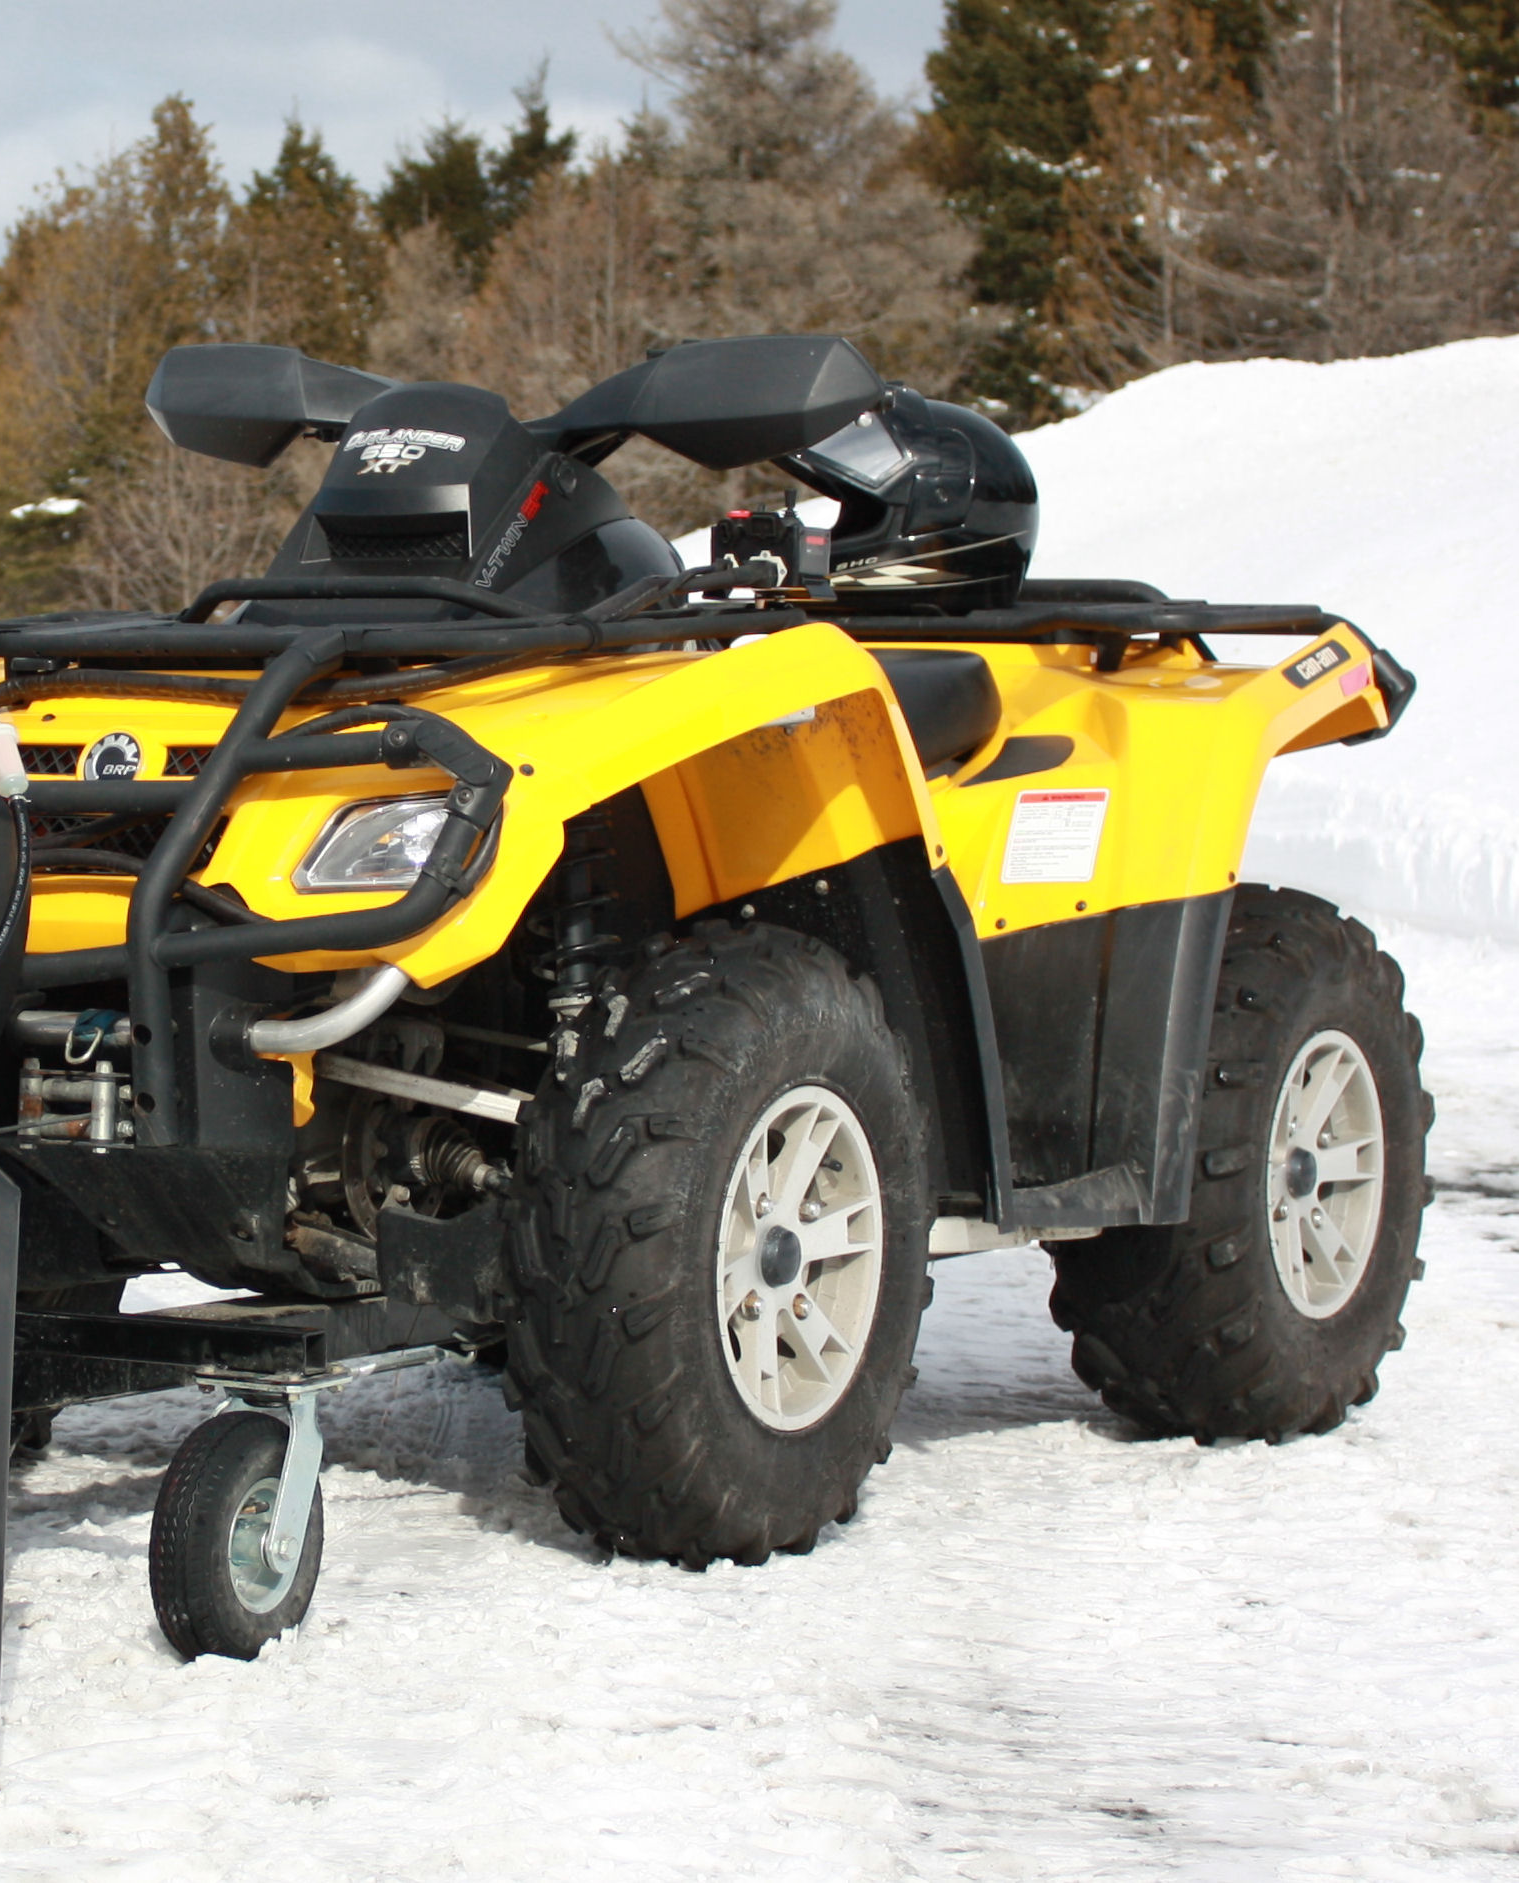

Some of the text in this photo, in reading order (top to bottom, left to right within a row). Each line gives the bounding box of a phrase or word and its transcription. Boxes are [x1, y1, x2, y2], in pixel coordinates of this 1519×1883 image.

[343, 428, 466, 452] OUTLANDER
[359, 443, 426, 460] 650
[357, 460, 412, 475] XT
[102, 764, 138, 776] BRP
